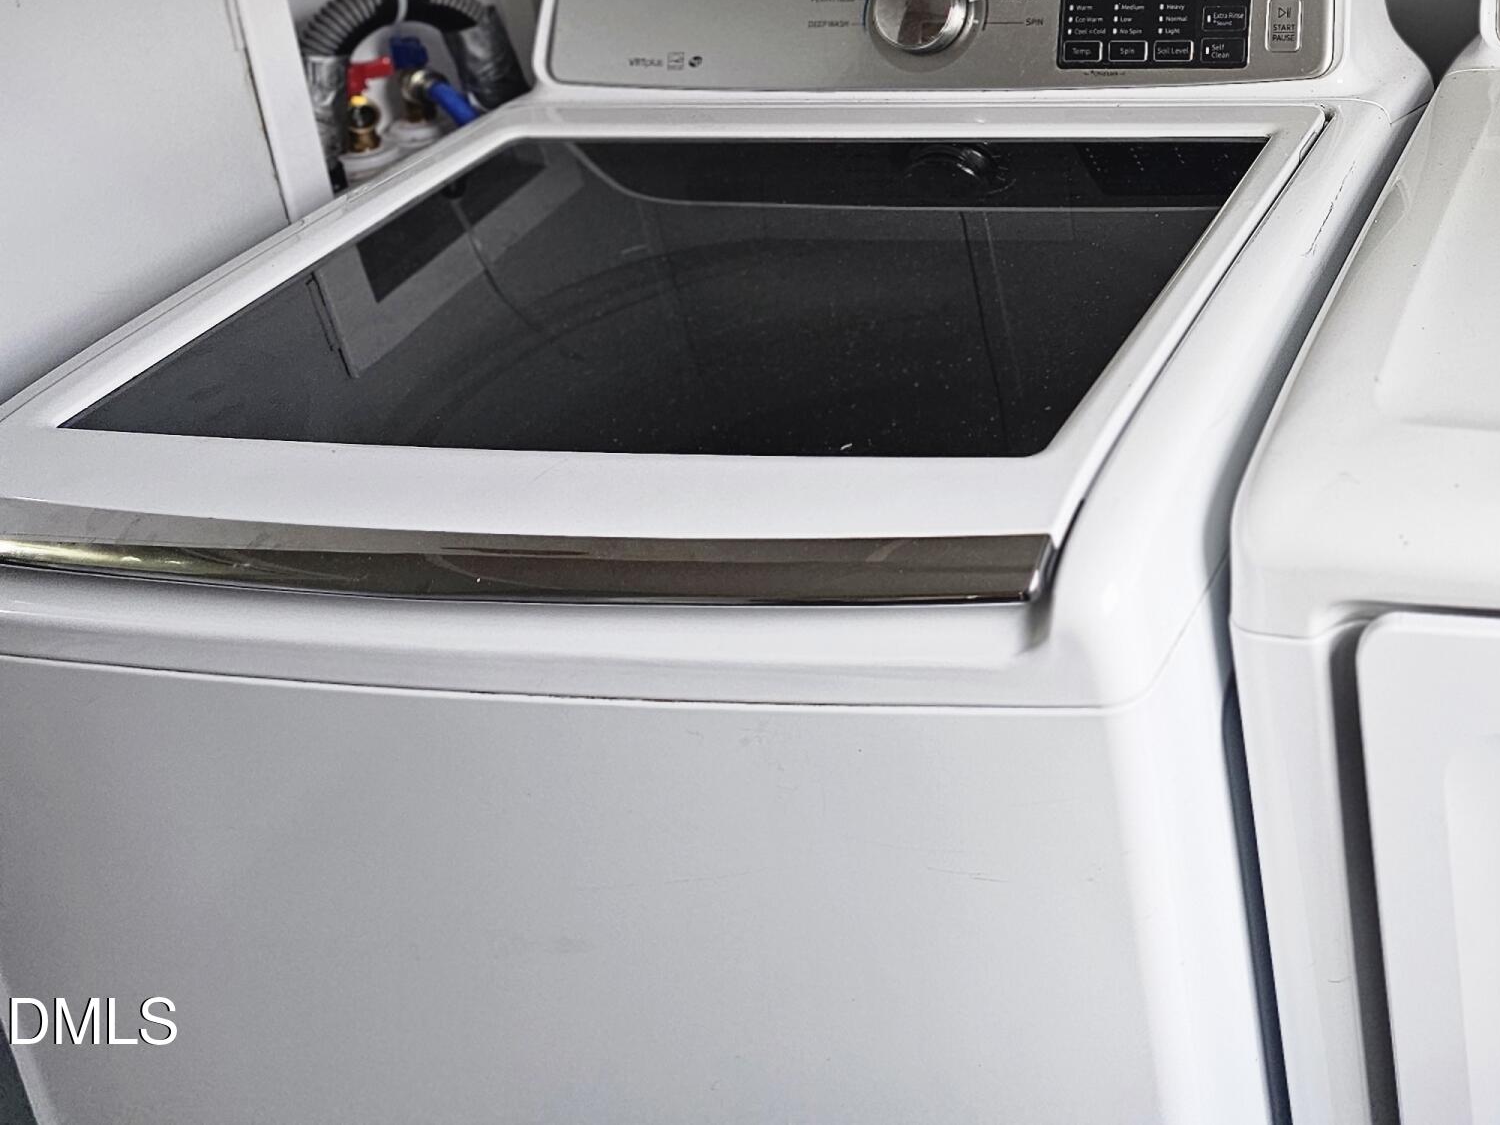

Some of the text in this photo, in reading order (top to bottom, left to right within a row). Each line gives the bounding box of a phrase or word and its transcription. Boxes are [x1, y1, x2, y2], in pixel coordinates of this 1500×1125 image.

[1166, 3, 1185, 11] Heavy
[1025, 18, 1044, 26] SPIN
[1165, 15, 1188, 23] Normal
[1165, 27, 1181, 35] Light
[1272, 23, 1296, 31] START
[1271, 34, 1296, 42] PAUSE
[1120, 47, 1135, 55] Spin
[1156, 46, 1190, 55] Soil Level
[1211, 51, 1231, 59] Clean
